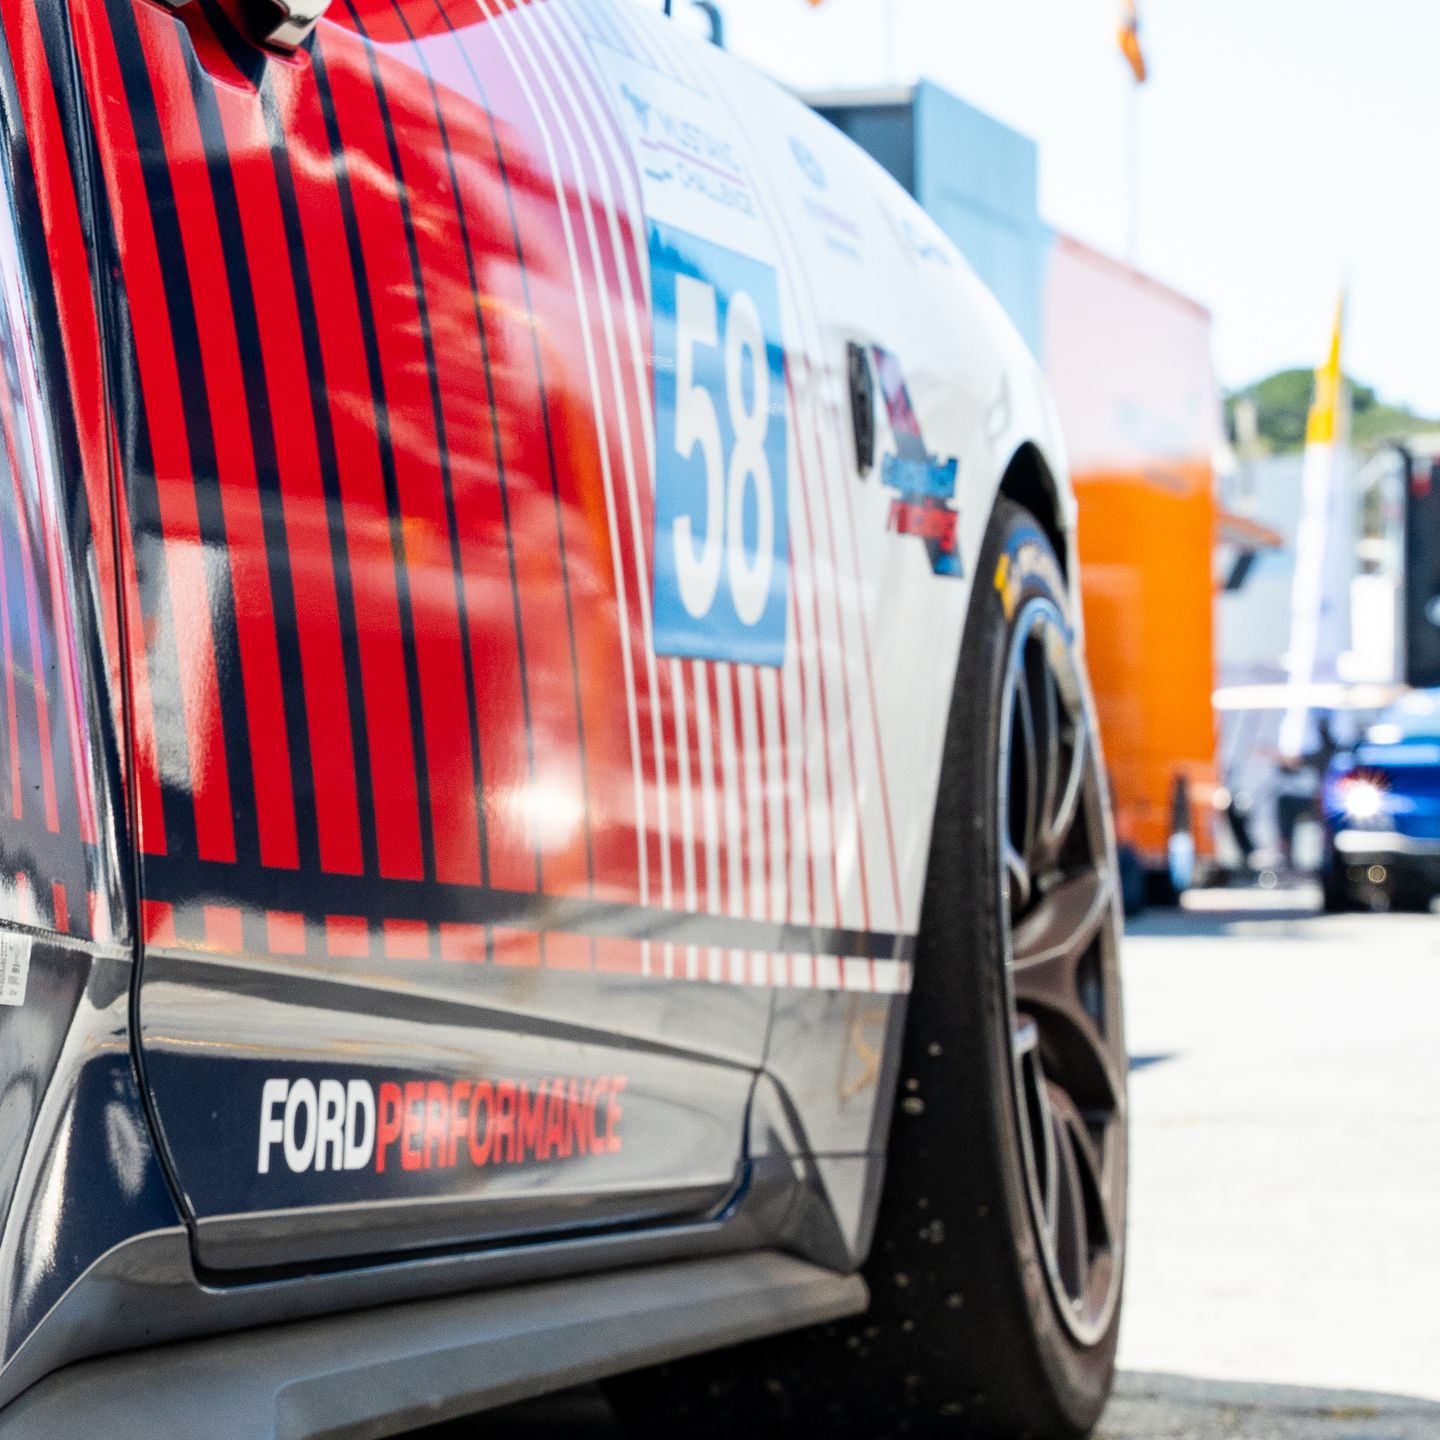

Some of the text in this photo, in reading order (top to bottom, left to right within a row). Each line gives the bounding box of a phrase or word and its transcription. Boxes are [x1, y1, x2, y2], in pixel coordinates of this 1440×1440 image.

[672, 271, 775, 627] 58
[257, 1073, 629, 1174] FORD PERFORMANCE
